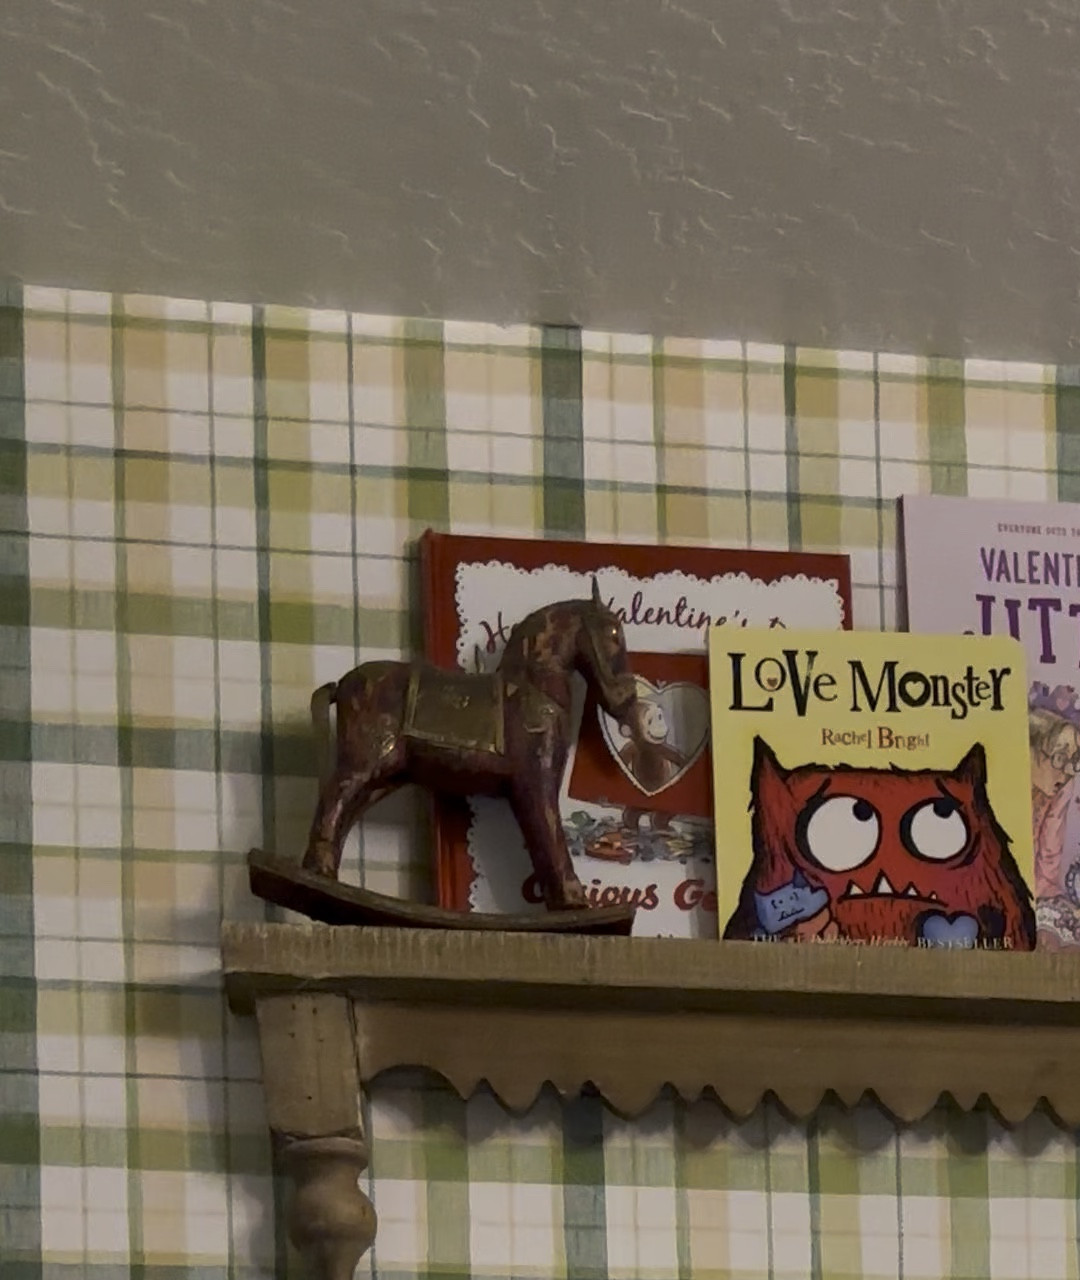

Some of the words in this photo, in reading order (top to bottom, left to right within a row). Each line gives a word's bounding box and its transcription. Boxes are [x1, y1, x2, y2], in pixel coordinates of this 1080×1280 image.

[847, 660, 1012, 720] Monster
[821, 728, 873, 750] Rachel
[877, 726, 930, 751] Bright
[521, 878, 660, 911] Cious
